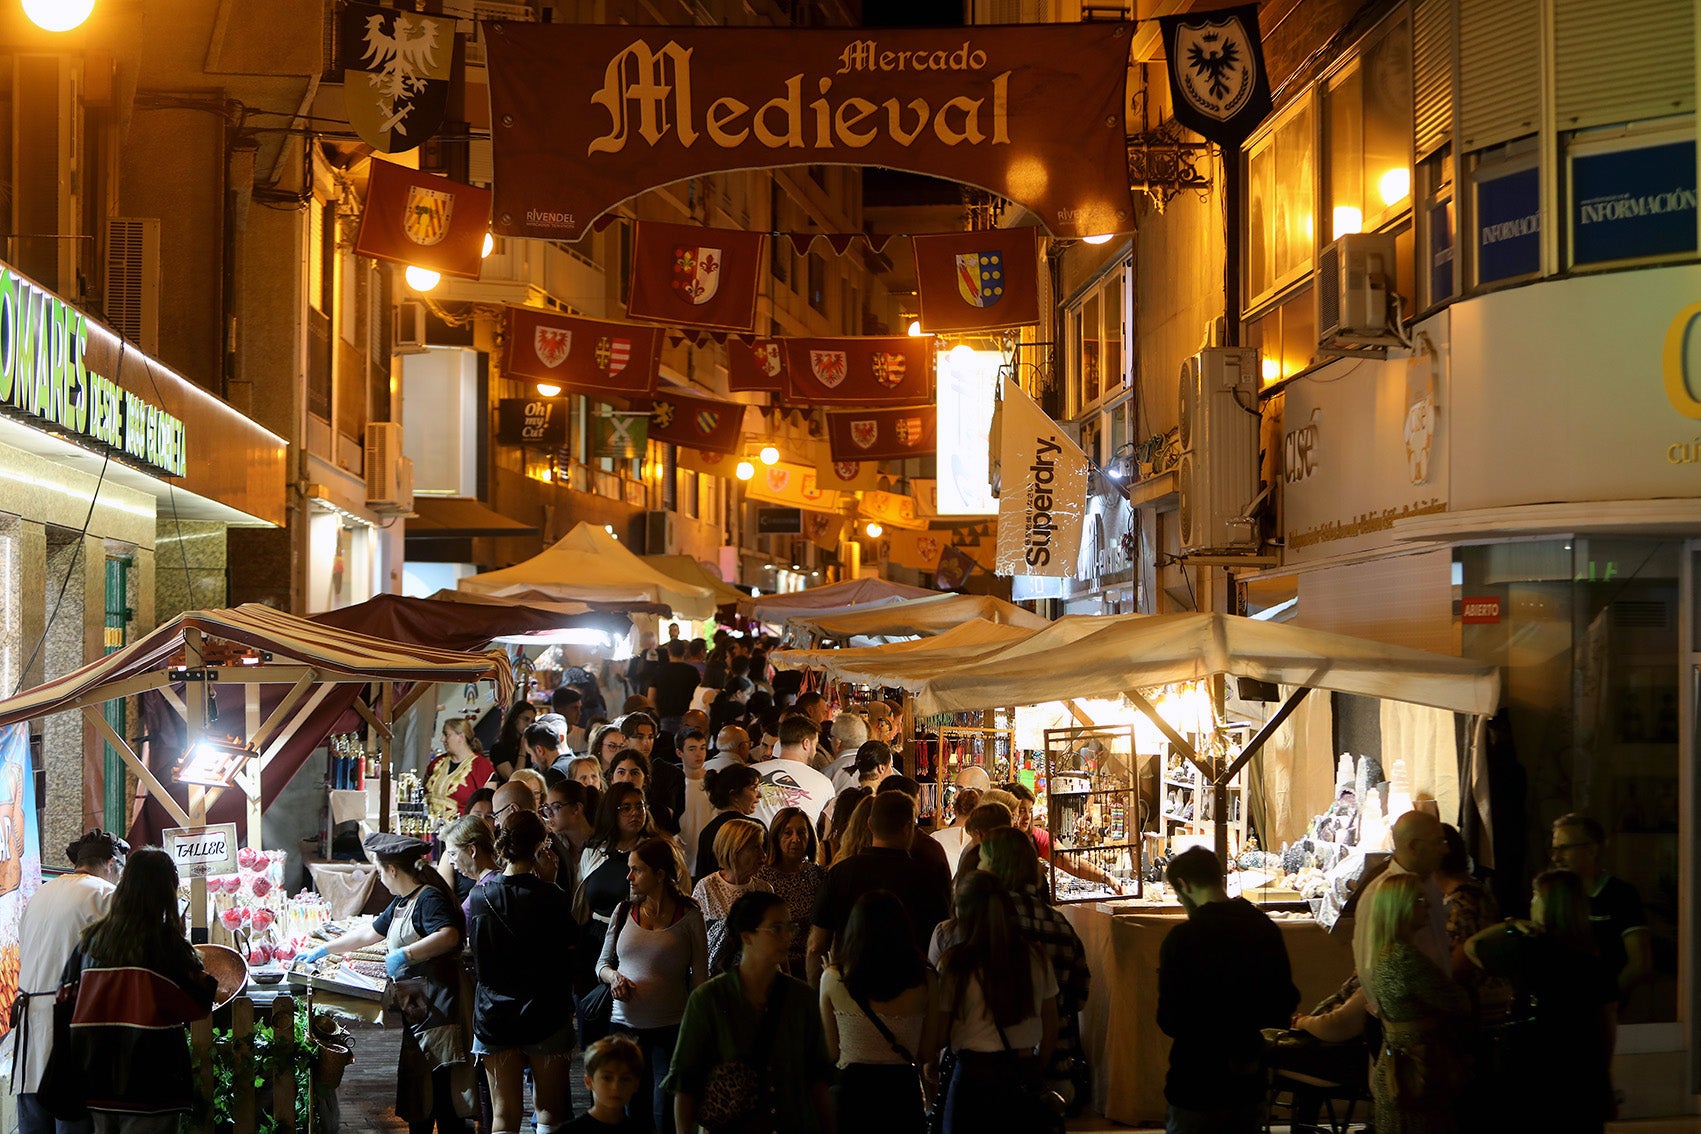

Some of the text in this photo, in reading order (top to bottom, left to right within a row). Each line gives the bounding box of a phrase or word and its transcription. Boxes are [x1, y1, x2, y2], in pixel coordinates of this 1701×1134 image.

[835, 40, 988, 75] Mercado
[588, 38, 1012, 157] Medieval
[90, 371, 123, 450] DESDE
[524, 401, 545, 416] Oh
[525, 417, 544, 429] my
[522, 426, 544, 437] Cut
[1463, 602, 1500, 617] ABIERTO
[176, 841, 225, 858] TALLER
